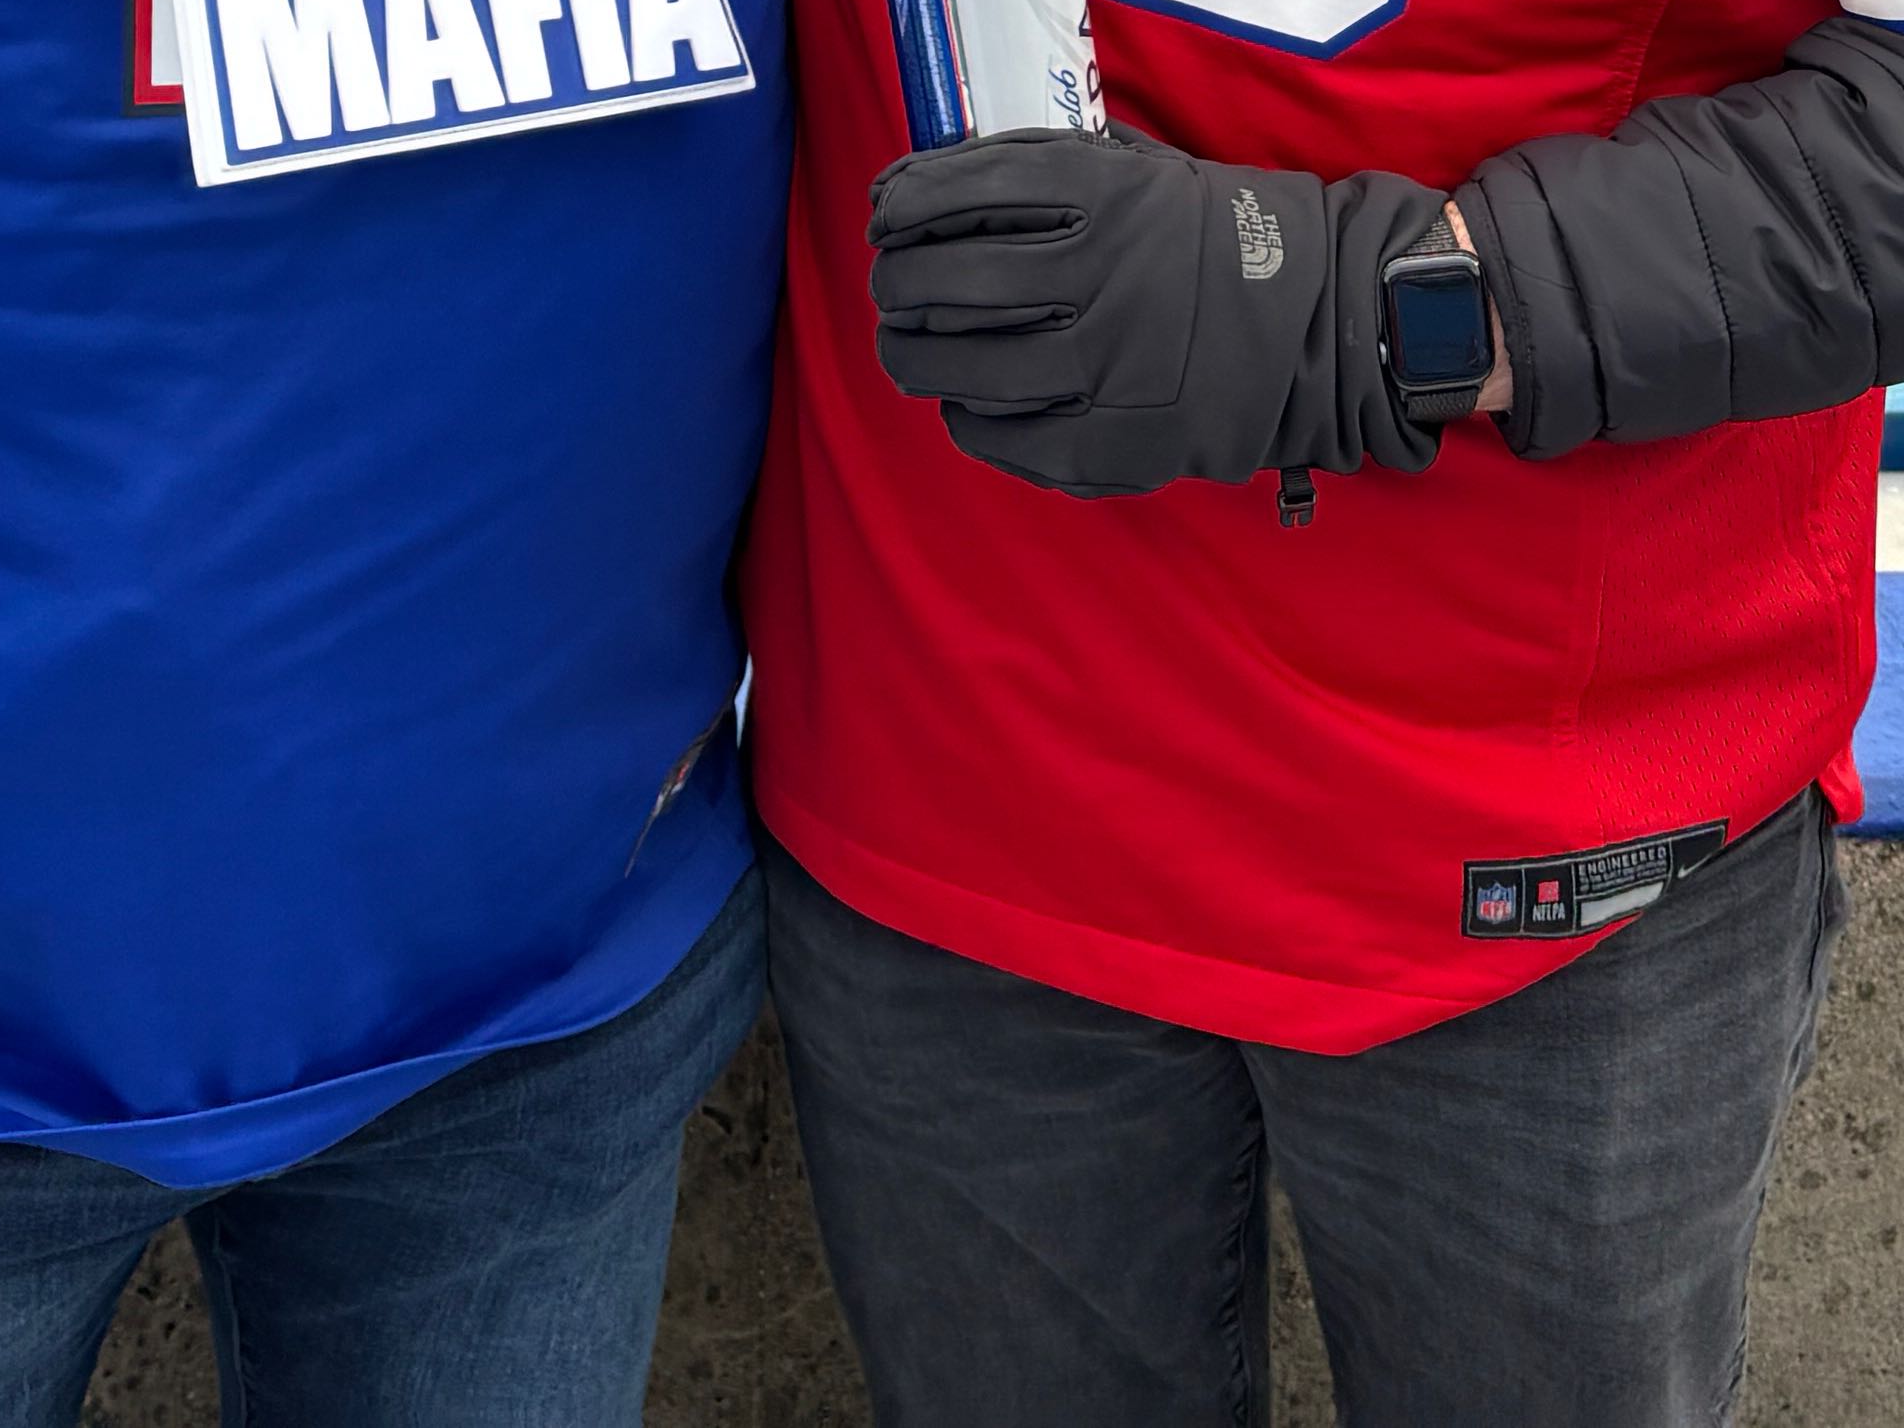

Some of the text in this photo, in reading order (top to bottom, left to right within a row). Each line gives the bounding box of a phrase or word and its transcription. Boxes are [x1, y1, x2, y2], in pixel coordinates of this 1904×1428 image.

[1231, 198, 1254, 244] FACE
[1239, 188, 1268, 247] NORTH
[1262, 213, 1283, 248] THE
[1578, 846, 1667, 878] ENGINEERED
